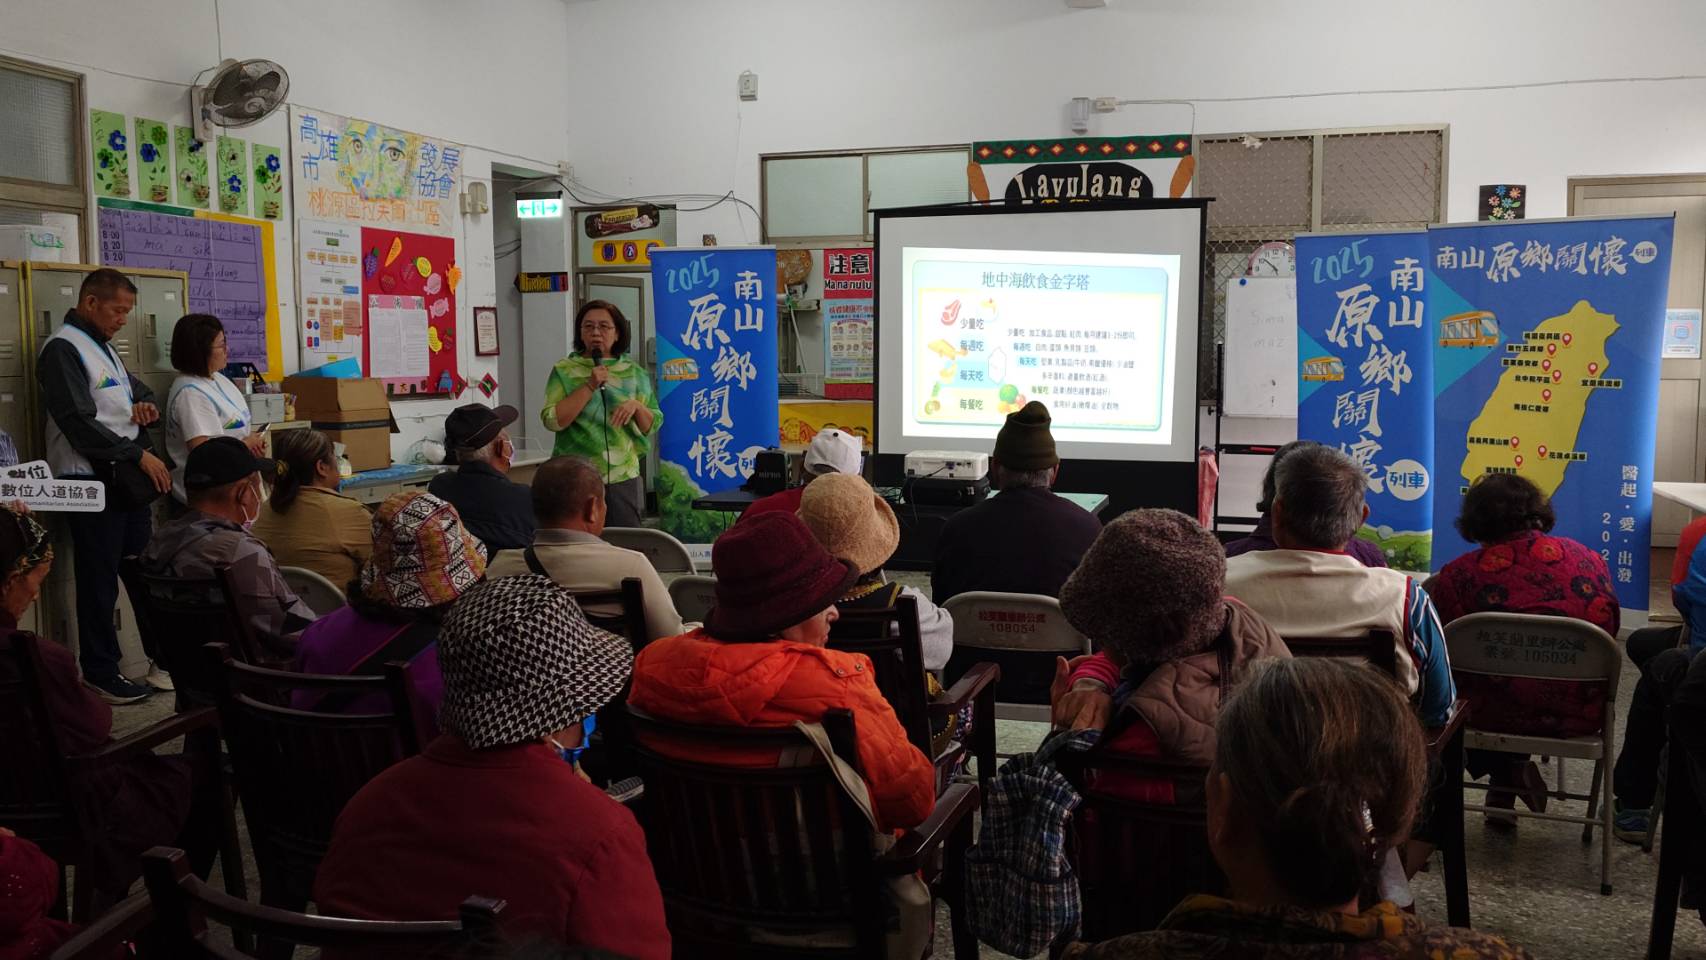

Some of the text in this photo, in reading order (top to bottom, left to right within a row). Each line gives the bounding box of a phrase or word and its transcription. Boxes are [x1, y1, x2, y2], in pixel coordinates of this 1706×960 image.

[829, 254, 871, 275] 注意
[1311, 238, 1375, 284] 2025
[665, 253, 720, 293] 2025
[981, 271, 1090, 291] 地中海飲食金字塔
[824, 279, 872, 291] Mananulu
[1388, 256, 1425, 329] 南山
[735, 270, 764, 332] 南山
[960, 317, 985, 330] 少量吃
[960, 340, 985, 352] 每週吃
[960, 369, 984, 382] 每天吃
[680, 293, 758, 480] 原鄉關懷
[960, 398, 984, 411] 每餐吃
[1389, 471, 1426, 489] 列車
[1, 483, 99, 500] 數位人道協會
[1601, 512, 1612, 561] 202
[1524, 650, 1577, 665] 105034
